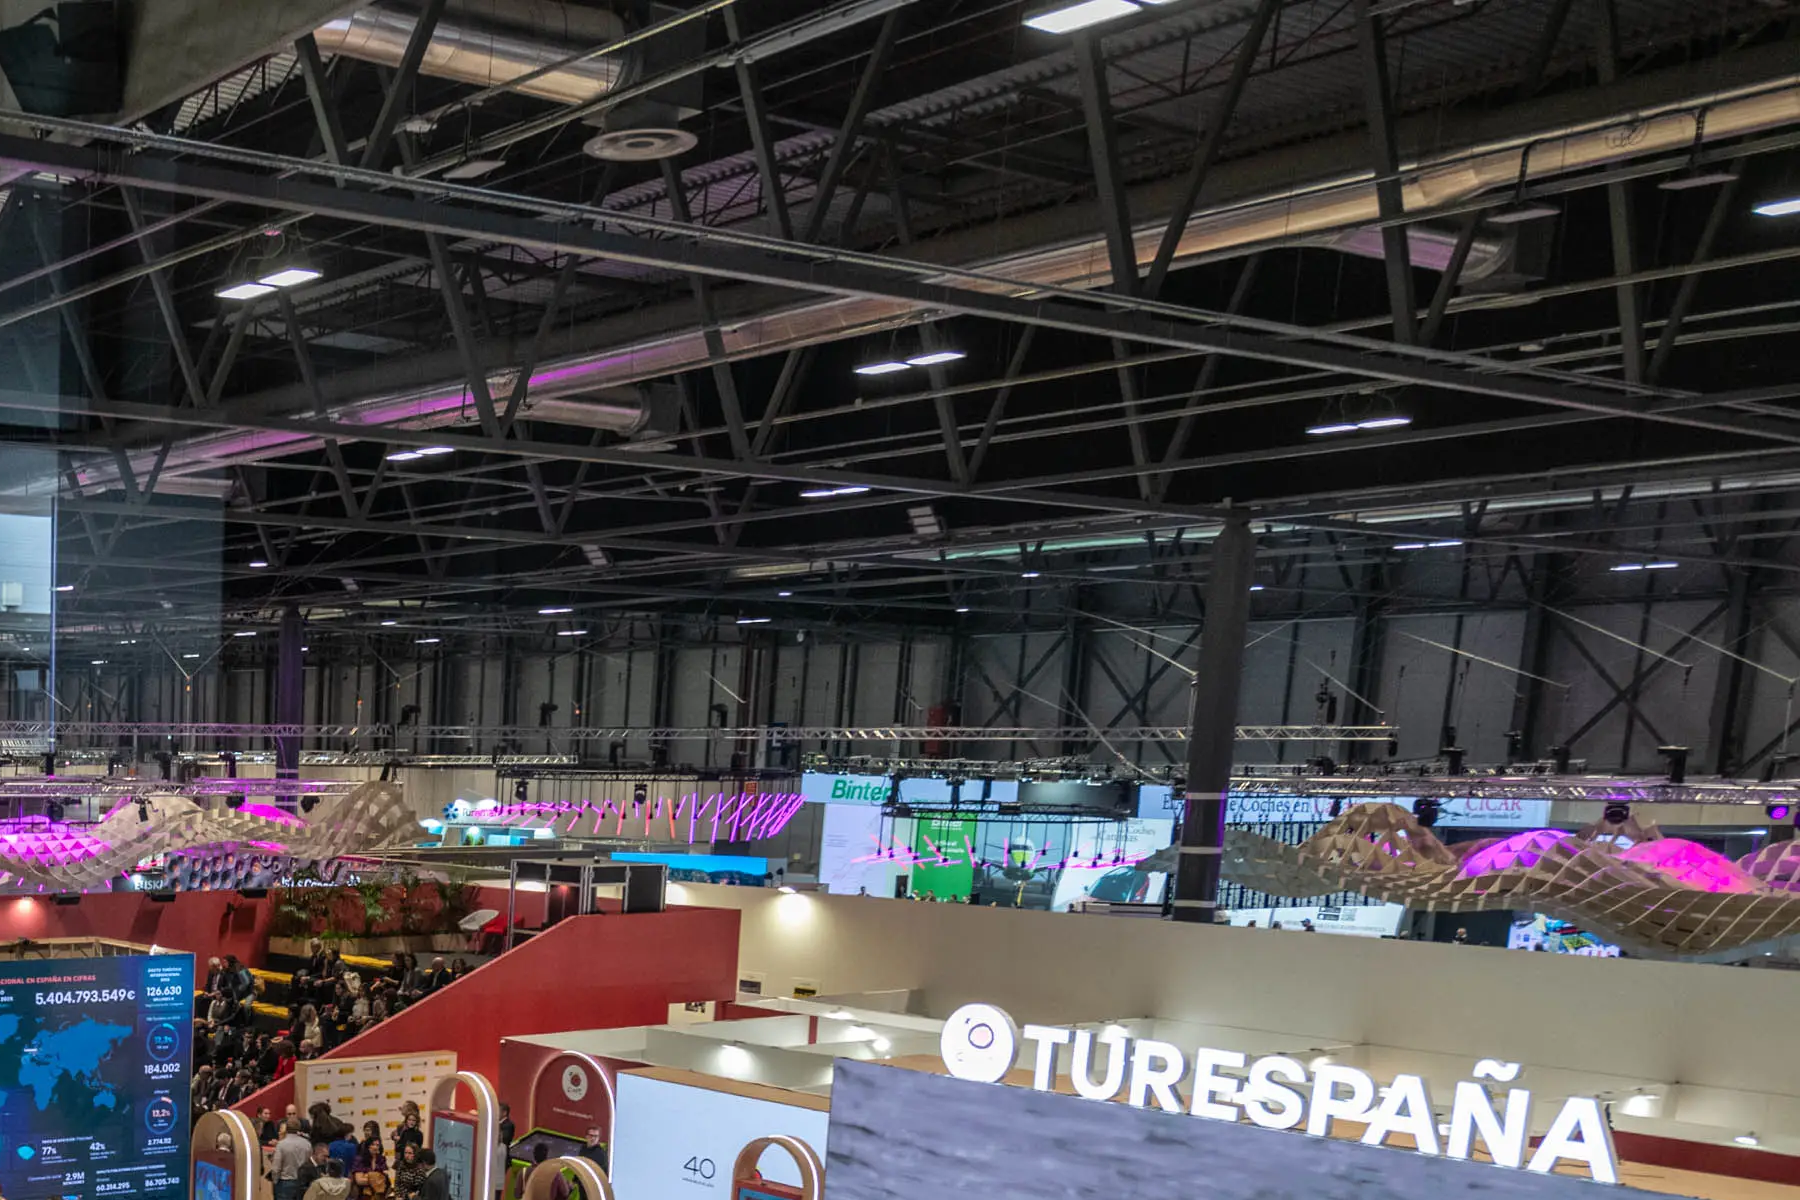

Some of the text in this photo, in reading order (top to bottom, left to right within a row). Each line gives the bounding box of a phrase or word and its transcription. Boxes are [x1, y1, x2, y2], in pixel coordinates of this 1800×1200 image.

[831, 779, 892, 801] Binter
[36, 975, 62, 984] ESPAÑA
[73, 974, 96, 982] CIFRAS
[35, 989, 136, 1005] 5.404.793.549€
[146, 986, 182, 997] 126.630
[144, 1063, 181, 1075] 184.002
[1023, 1023, 1619, 1184] TURESPAÑA
[683, 1156, 716, 1179] 40
[65, 1172, 85, 1181] 2.9M
